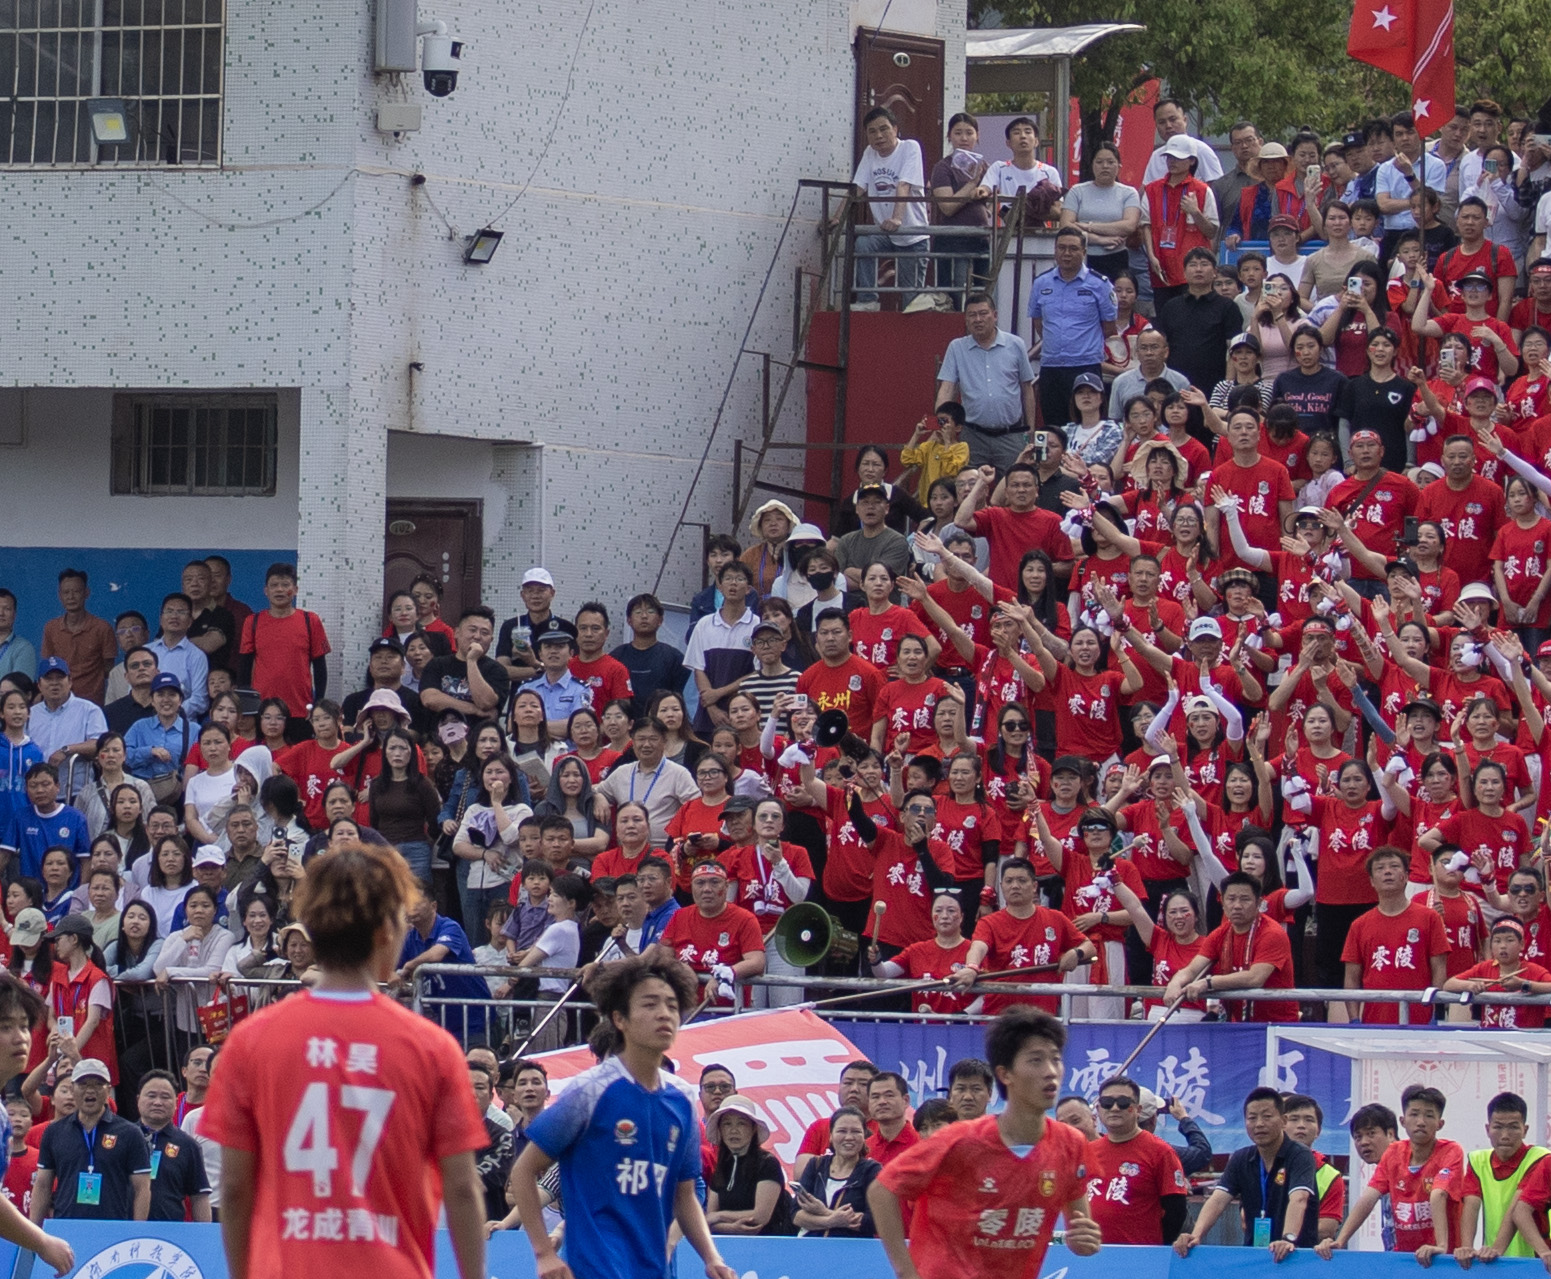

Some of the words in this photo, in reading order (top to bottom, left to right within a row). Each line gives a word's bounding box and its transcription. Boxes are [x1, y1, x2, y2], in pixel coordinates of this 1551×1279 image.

[1503, 555, 1543, 580] 零陵
[818, 690, 850, 712] 永州
[1067, 693, 1106, 720] 零陵
[892, 708, 931, 731] 零陵
[1328, 828, 1372, 851] 零陵
[679, 945, 719, 969] 零陵
[1009, 942, 1052, 968] 零陵
[1371, 945, 1415, 970] 零陵
[305, 1037, 378, 1075] 林昊
[283, 1082, 396, 1198] 47
[978, 1207, 1045, 1237] 零陵
